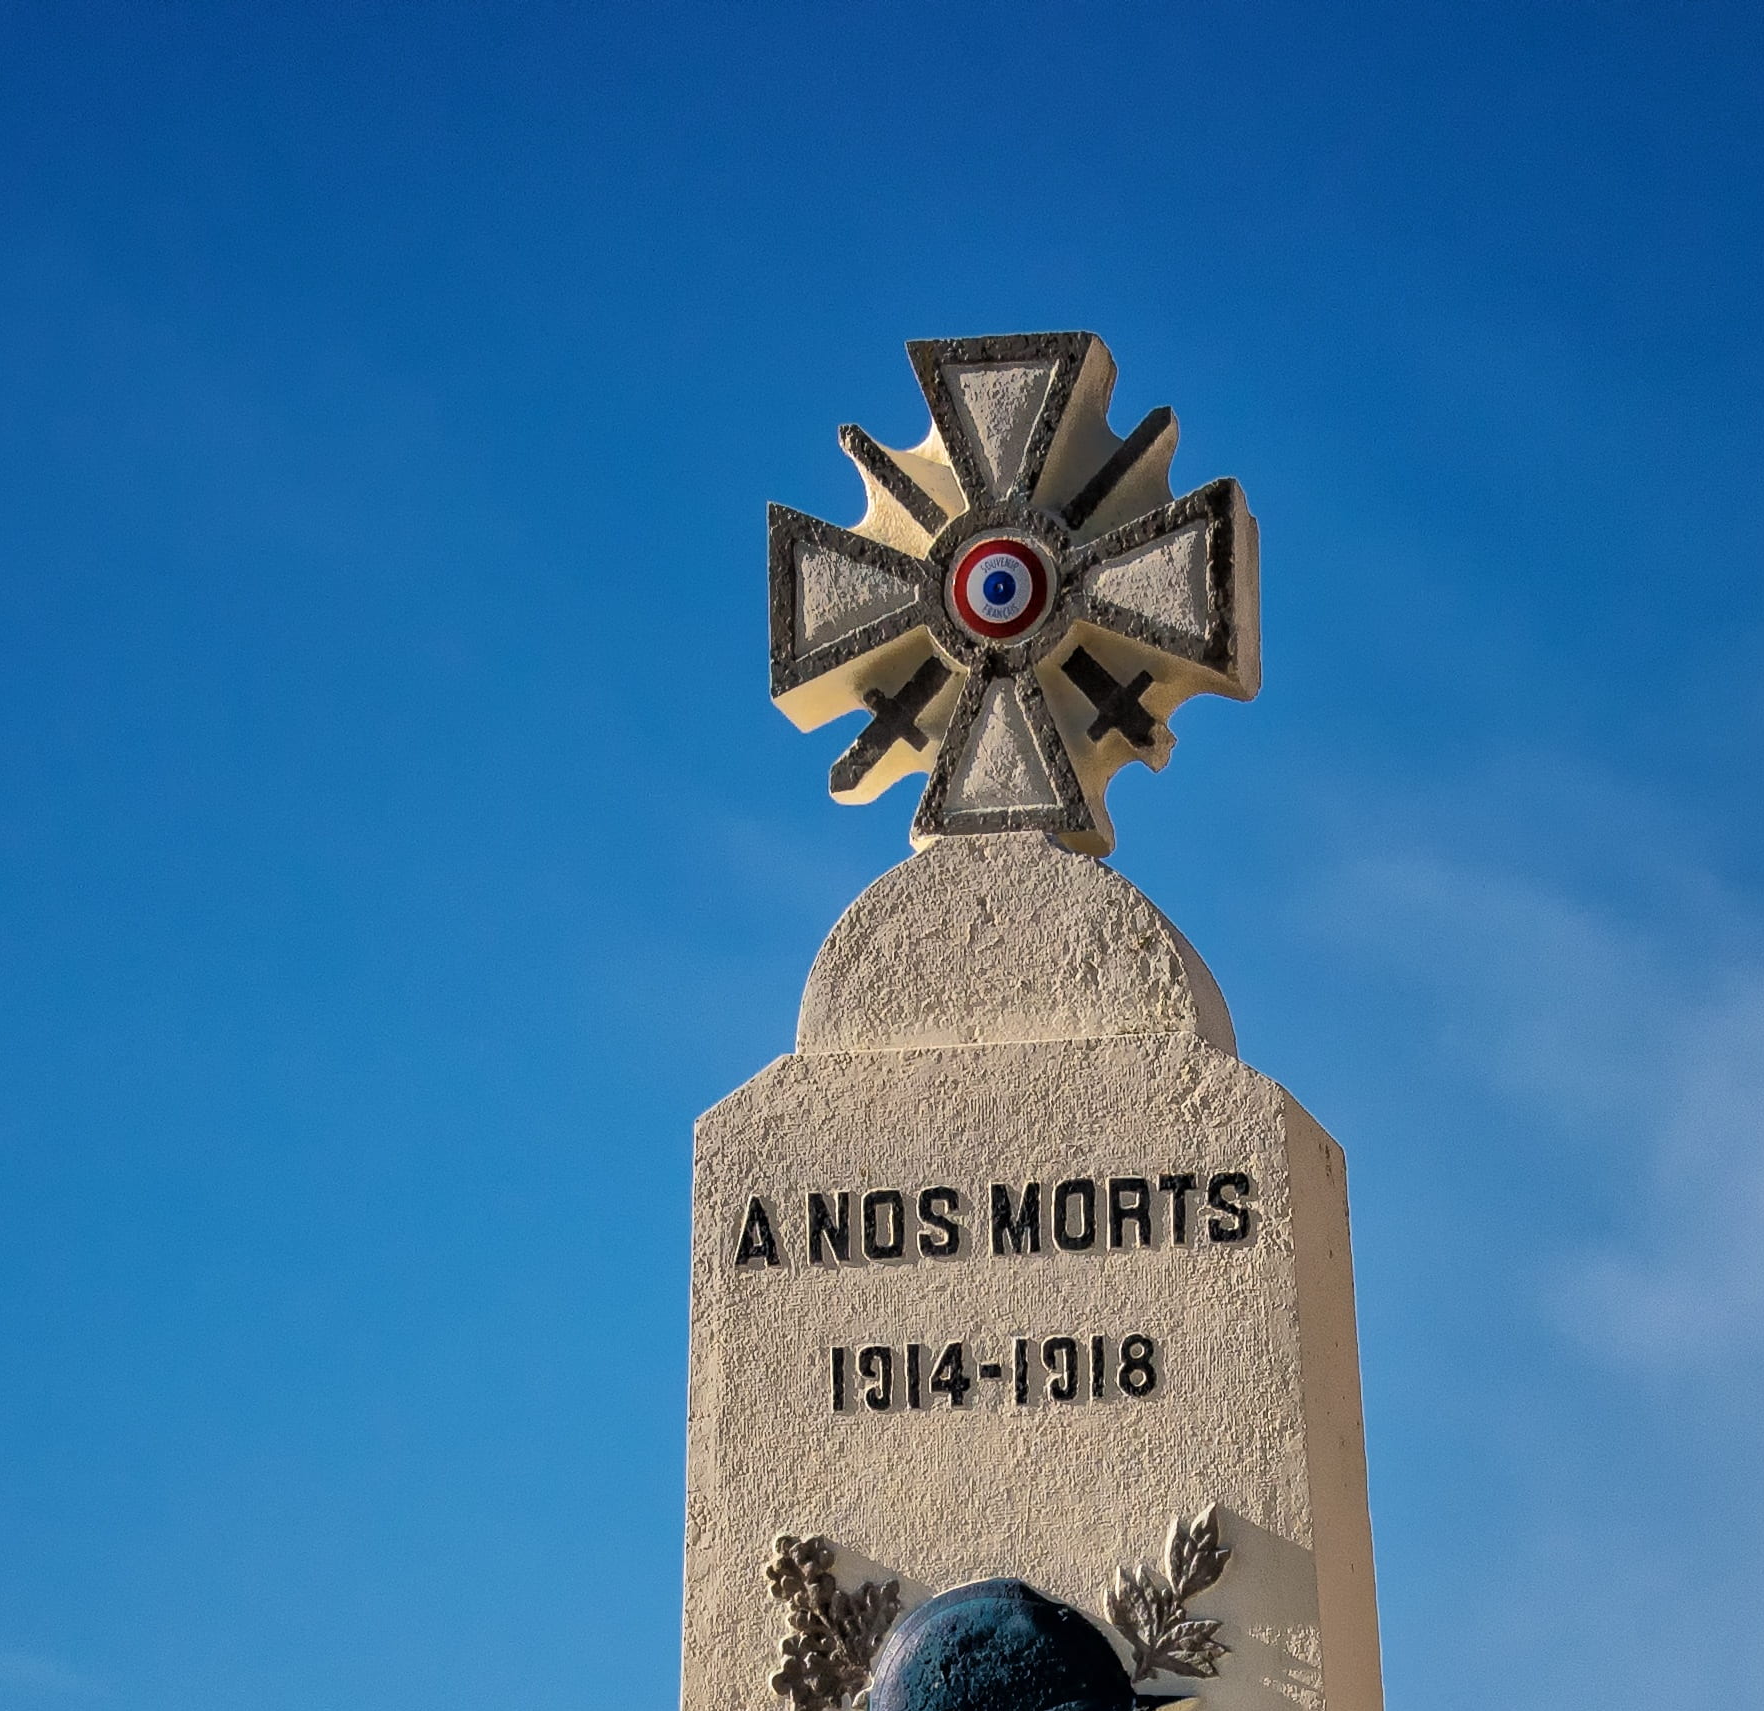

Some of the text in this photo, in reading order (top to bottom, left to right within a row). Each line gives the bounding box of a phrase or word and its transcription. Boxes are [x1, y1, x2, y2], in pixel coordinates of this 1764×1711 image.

[980, 557, 1019, 573] SOUVENIR
[736, 1172, 1253, 1267] A NOS MORTS
[830, 1333, 1159, 1412] 1914-1918
